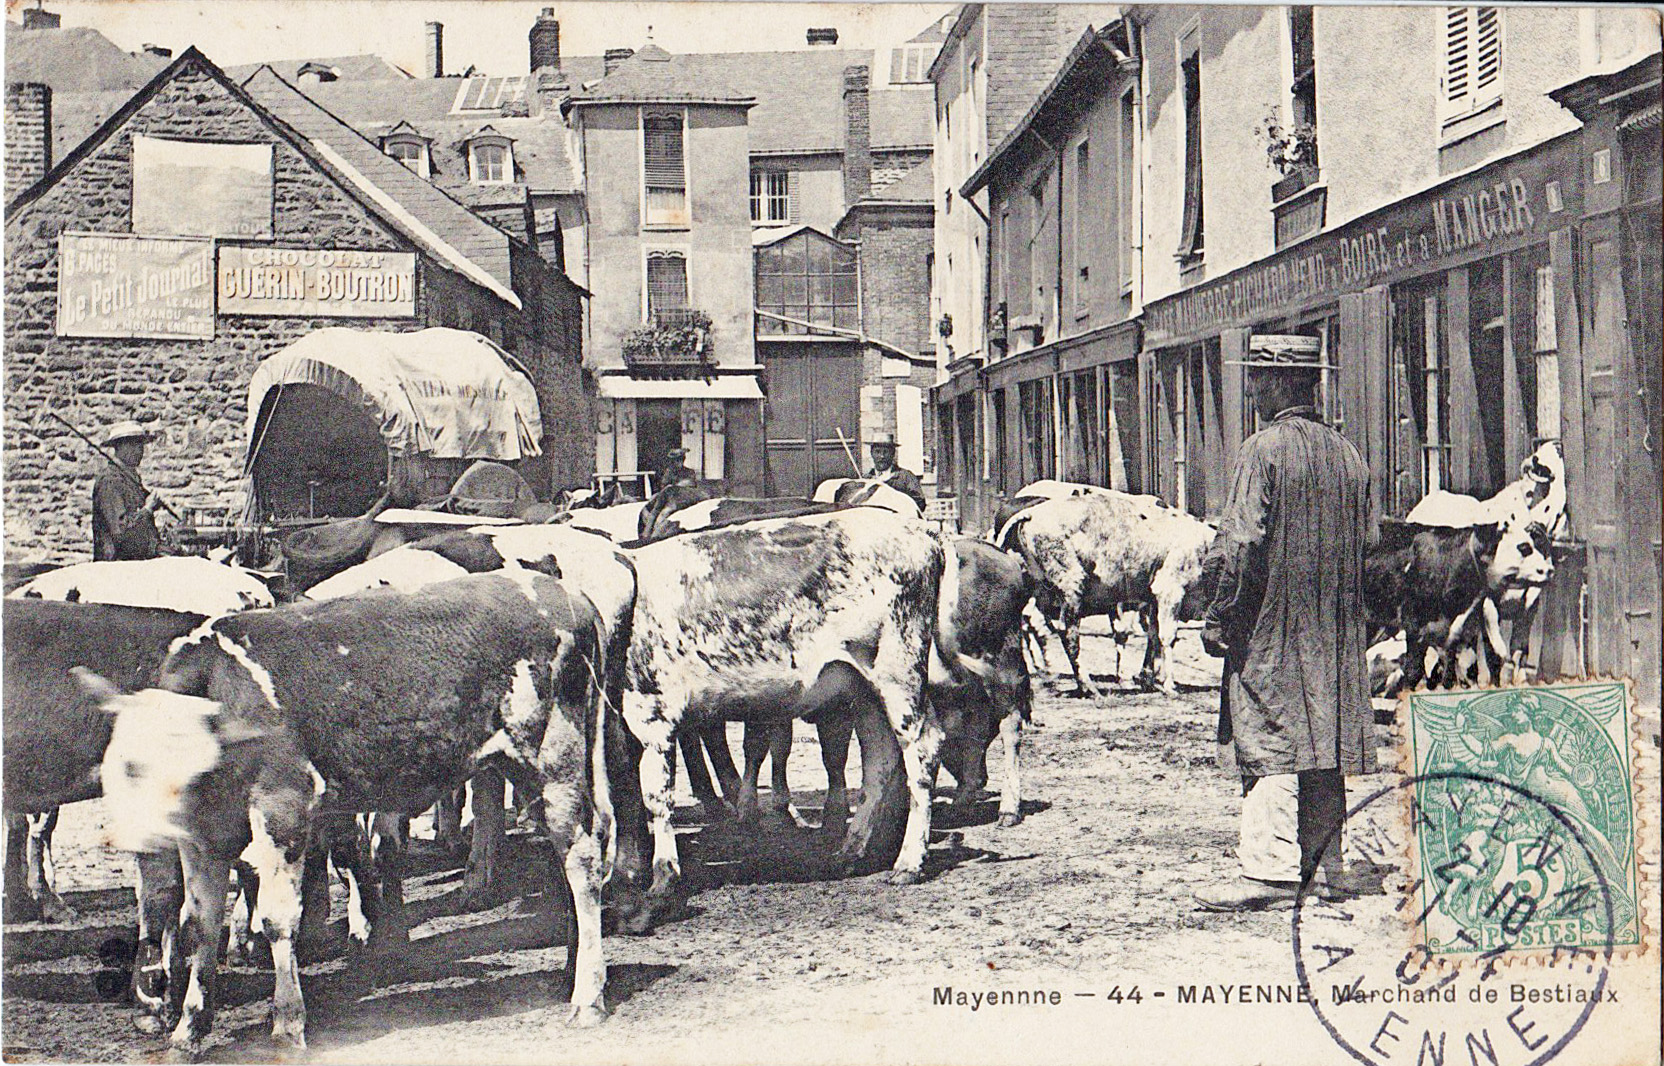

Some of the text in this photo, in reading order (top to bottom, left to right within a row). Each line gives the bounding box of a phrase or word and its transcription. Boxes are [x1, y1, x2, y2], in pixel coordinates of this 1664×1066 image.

[1339, 226, 1391, 285] BOIRE
[1396, 230, 1413, 267] et
[1432, 176, 1535, 256] MANGER
[79, 252, 117, 274] PAGES
[247, 250, 385, 268] CHOCOLAT
[65, 248, 209, 327] Le Petit Journal
[101, 321, 206, 334] DU MONDE ENTIER
[1485, 921, 1577, 950] POSTES
